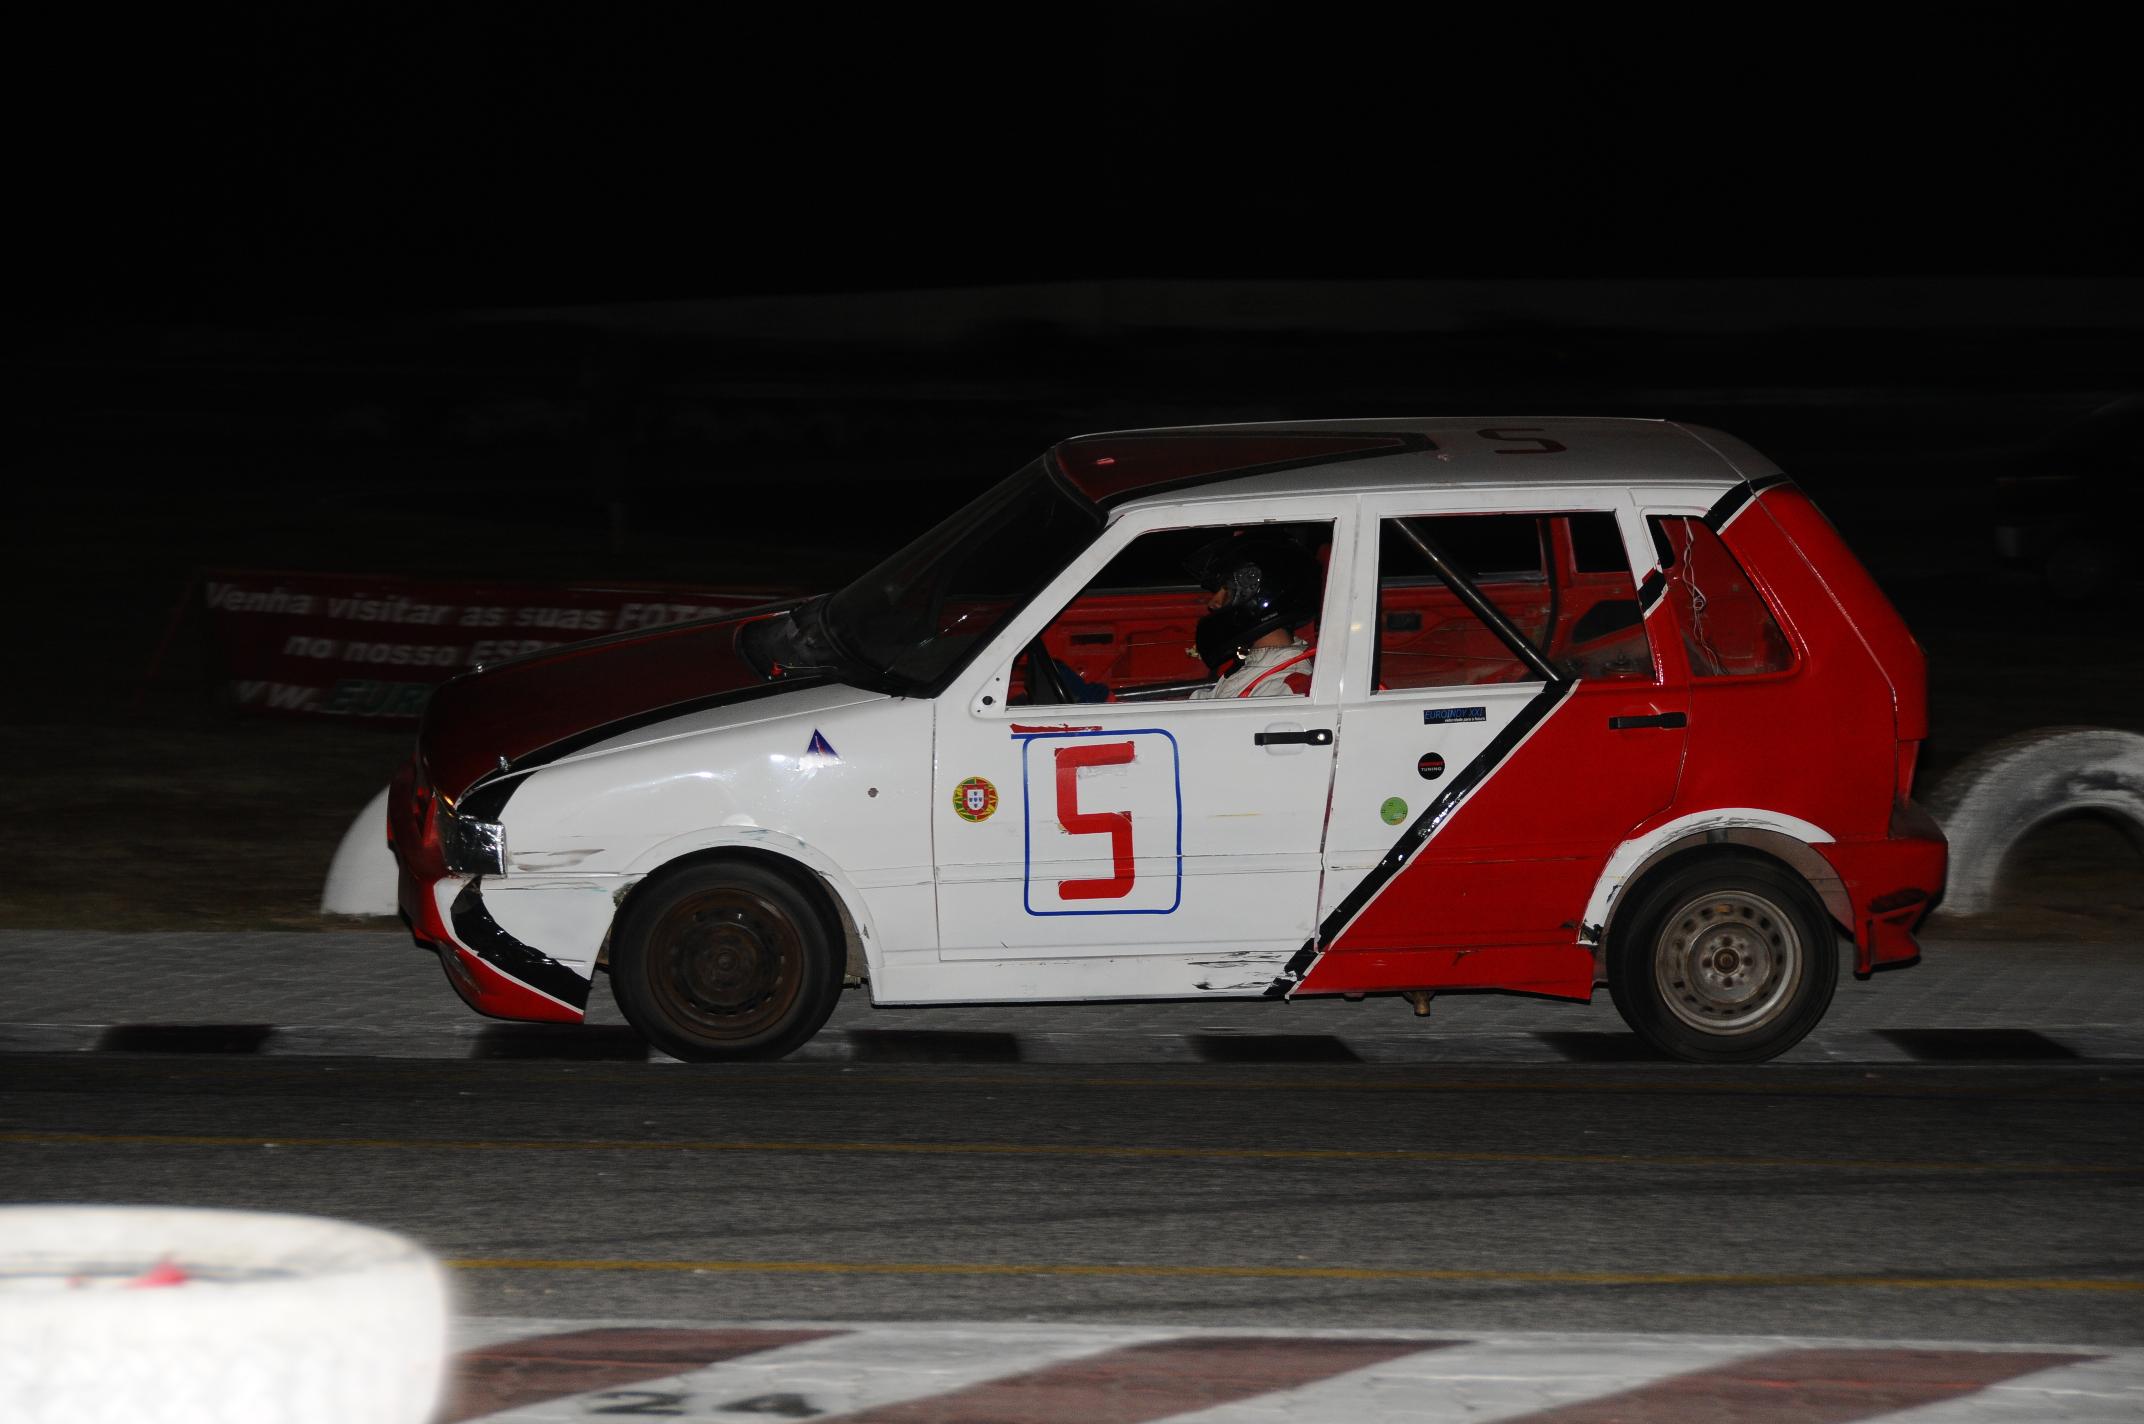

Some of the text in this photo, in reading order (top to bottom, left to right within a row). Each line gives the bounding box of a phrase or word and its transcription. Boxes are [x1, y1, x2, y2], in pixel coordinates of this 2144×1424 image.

[206, 581, 316, 617] Venha
[327, 592, 457, 628] visitar
[458, 605, 508, 630] as
[513, 607, 607, 632] suas
[281, 633, 338, 659] no
[341, 640, 461, 667] nosso
[1054, 740, 1136, 901] 5
